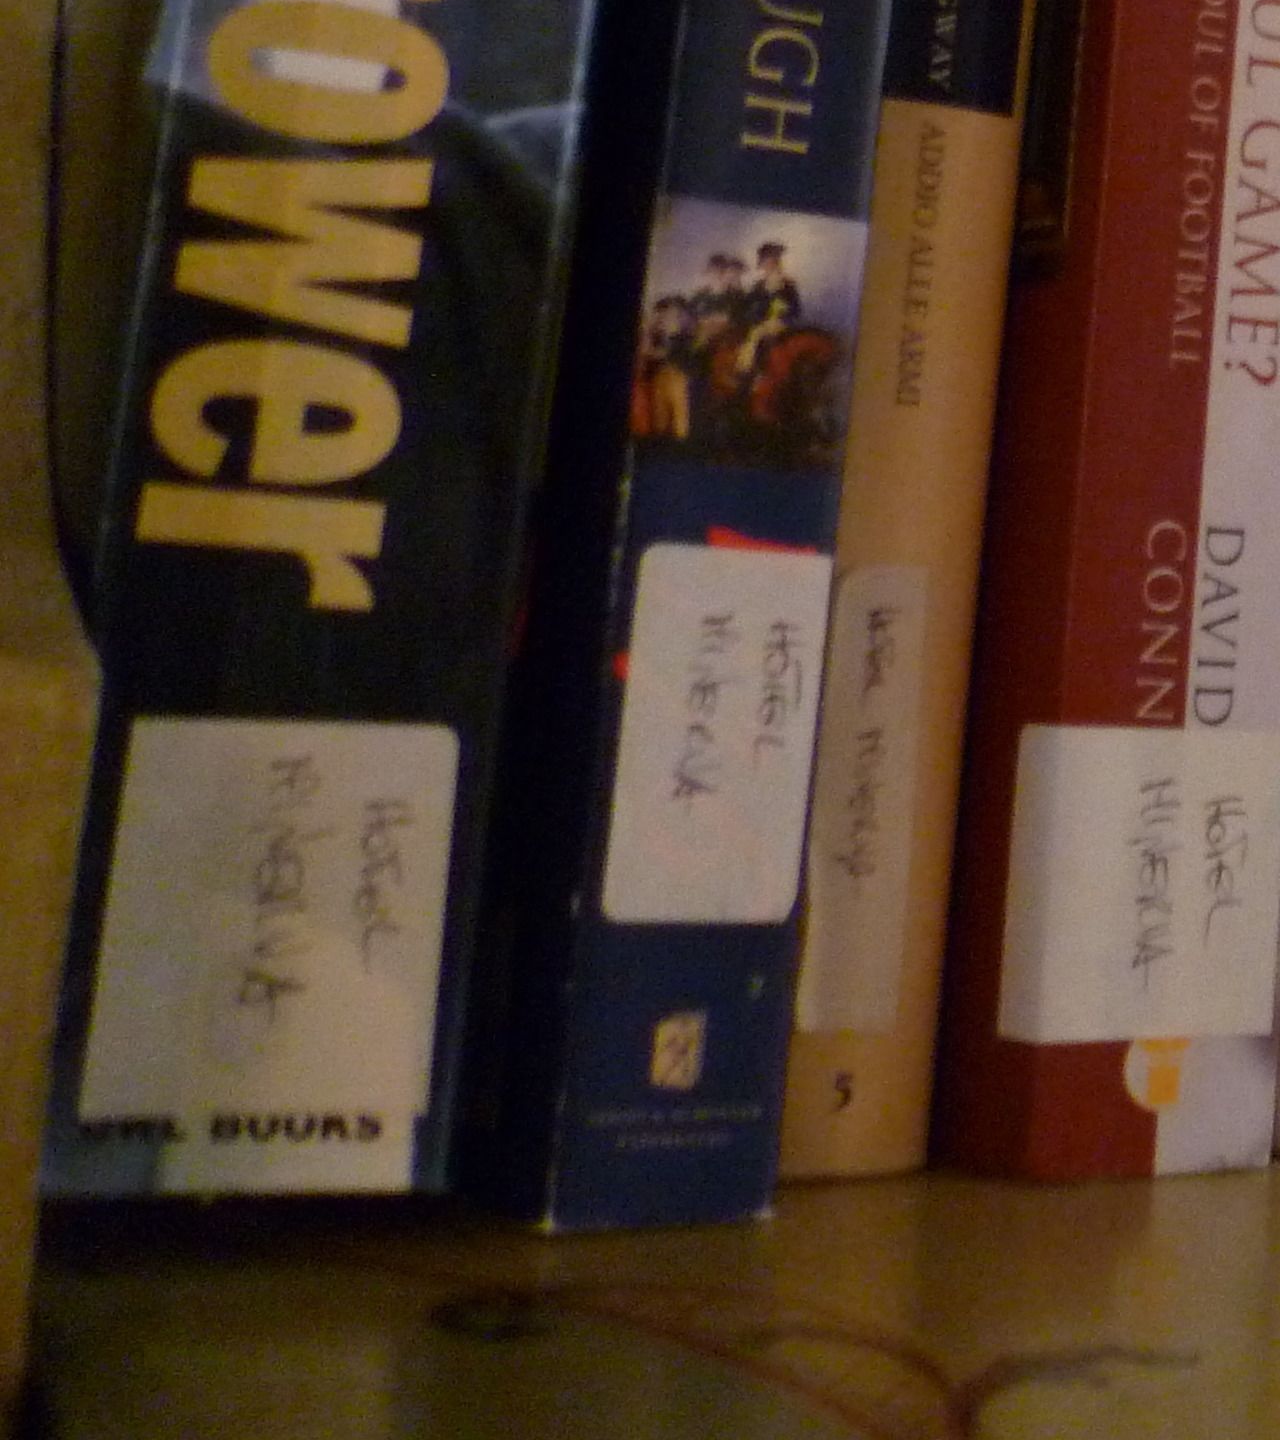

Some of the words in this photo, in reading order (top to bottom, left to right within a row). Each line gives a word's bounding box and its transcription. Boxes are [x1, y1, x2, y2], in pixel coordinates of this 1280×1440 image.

[1190, 76, 1221, 133] OF
[1171, 151, 1214, 369] FOOTBALL
[1136, 519, 1188, 720] CONN
[1193, 526, 1246, 727] DAVID
